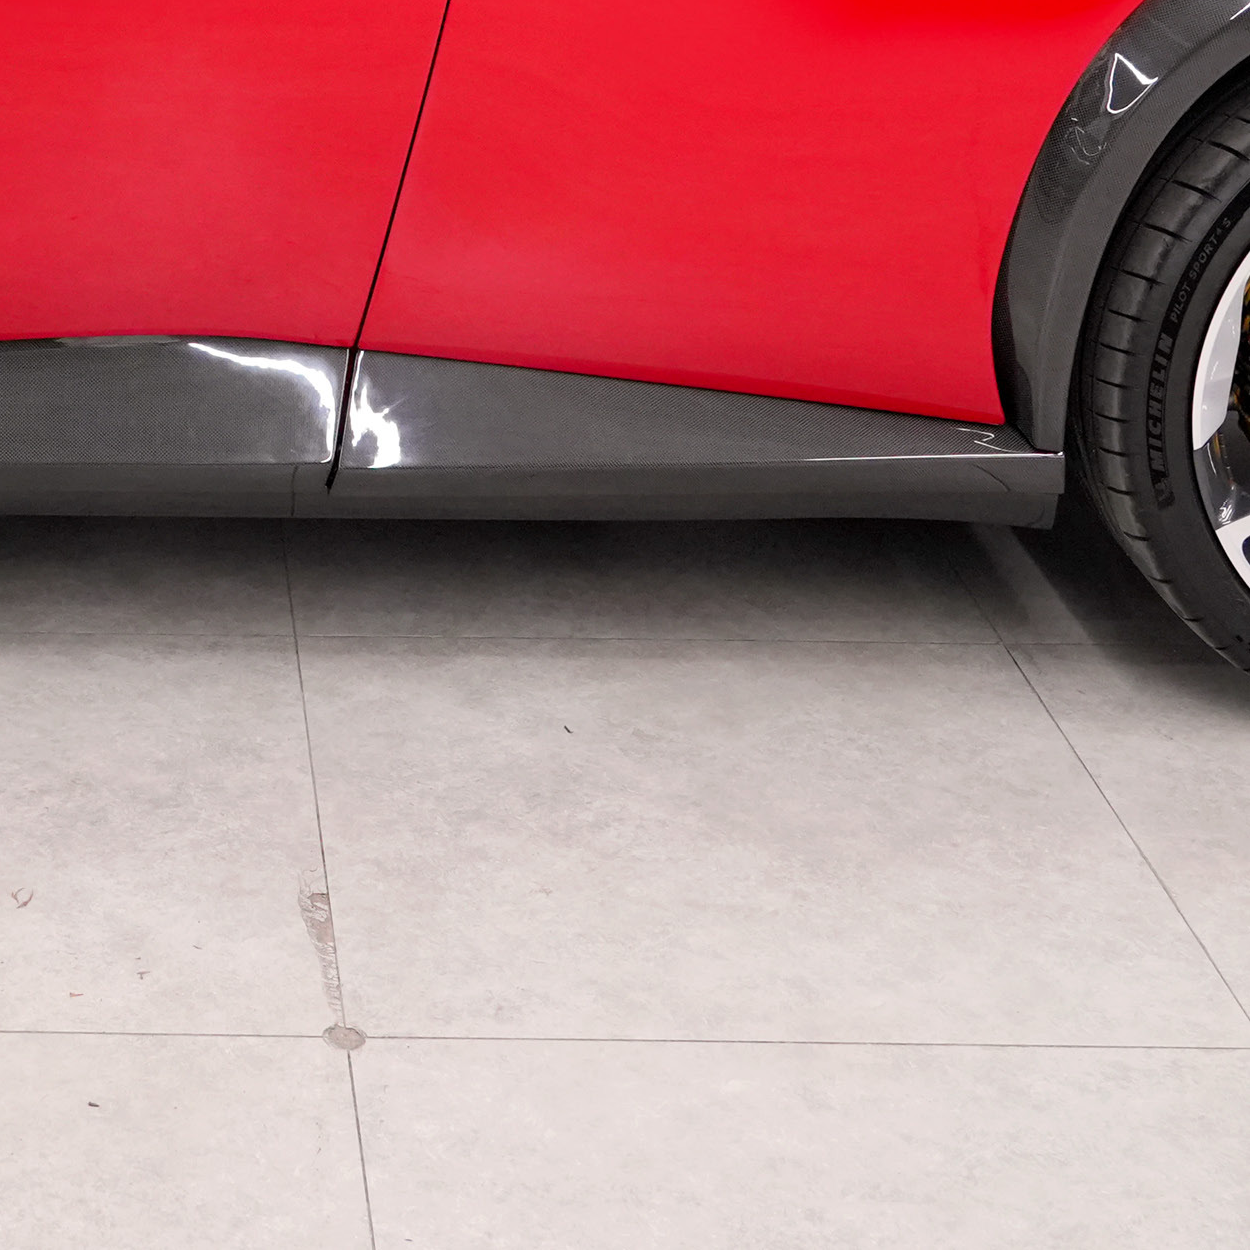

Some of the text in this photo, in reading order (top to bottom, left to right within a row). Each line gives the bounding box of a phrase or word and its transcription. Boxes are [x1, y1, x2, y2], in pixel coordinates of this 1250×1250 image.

[1149, 333, 1174, 472] MICHELIN
[1170, 282, 1191, 323] PILOT
[1190, 236, 1219, 279] SPORT
